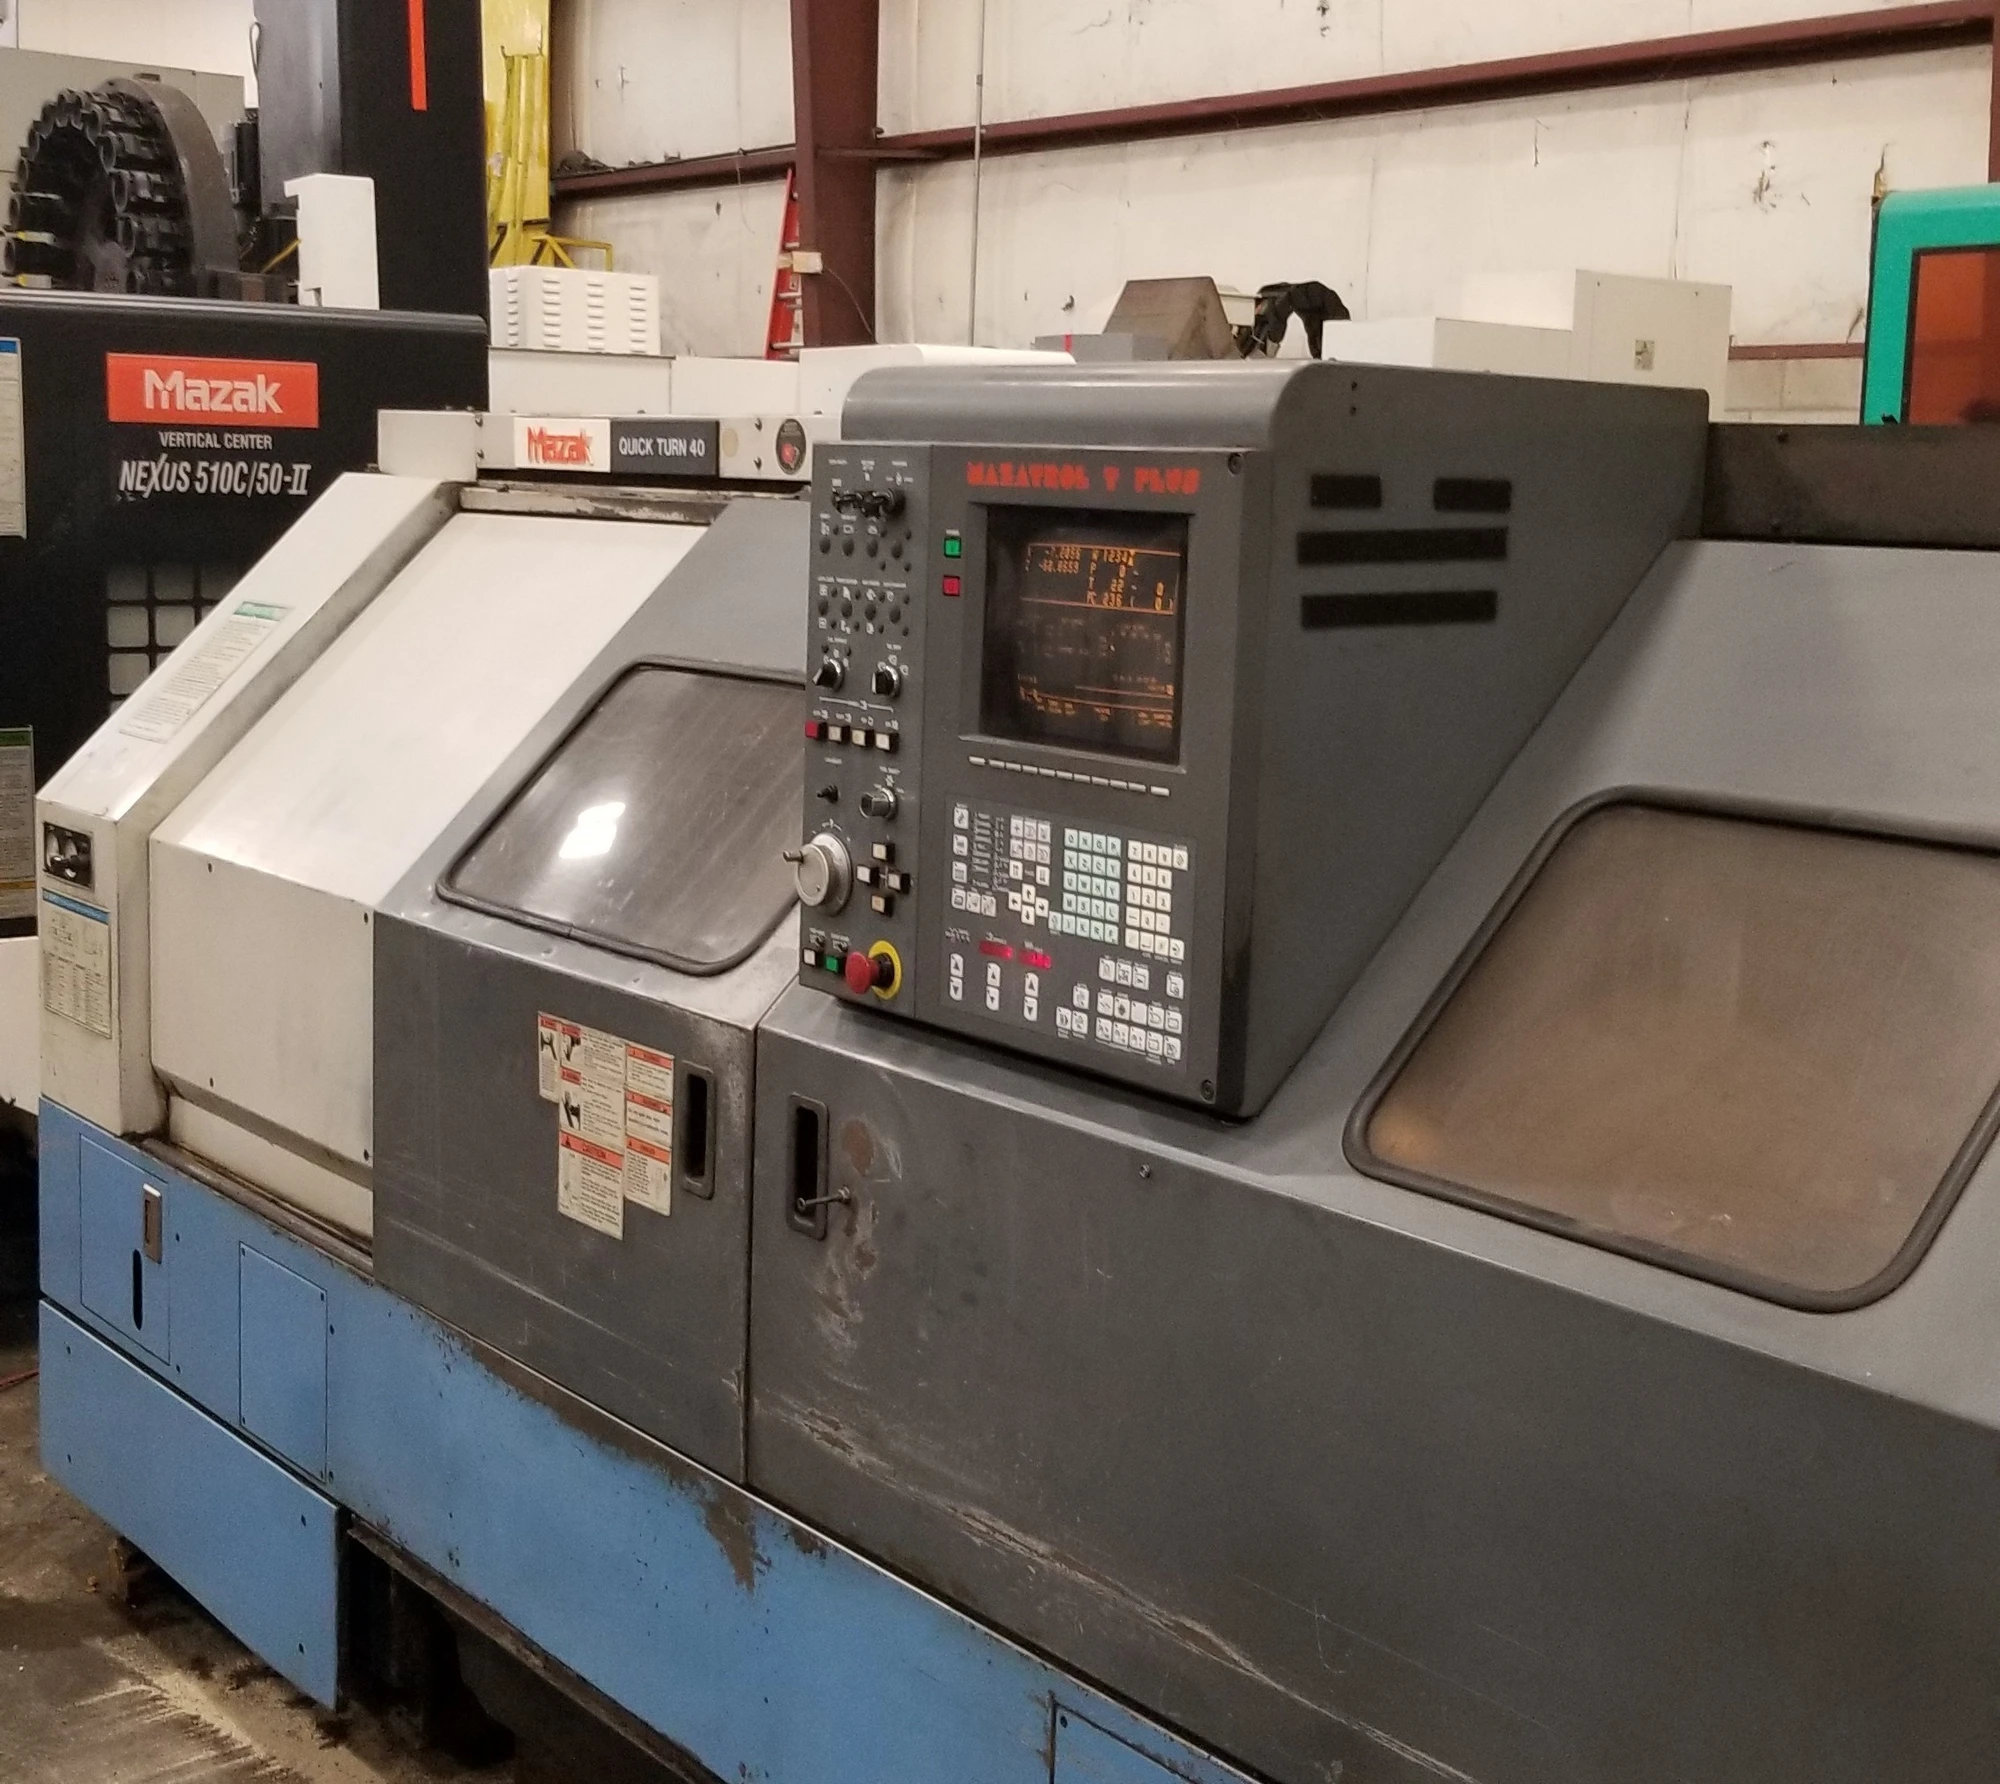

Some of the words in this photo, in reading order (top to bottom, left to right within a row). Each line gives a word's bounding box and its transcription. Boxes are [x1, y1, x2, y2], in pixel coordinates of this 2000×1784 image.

[143, 369, 283, 414] Mazak
[159, 431, 221, 449] VERTICAL
[224, 434, 273, 450] CENTER
[527, 426, 594, 466] Mazak
[618, 436, 654, 456] QUICK
[656, 437, 687, 457] TURN
[689, 438, 706, 457] 40
[118, 452, 192, 499] NEXUS
[194, 460, 312, 498] 510C/50-II
